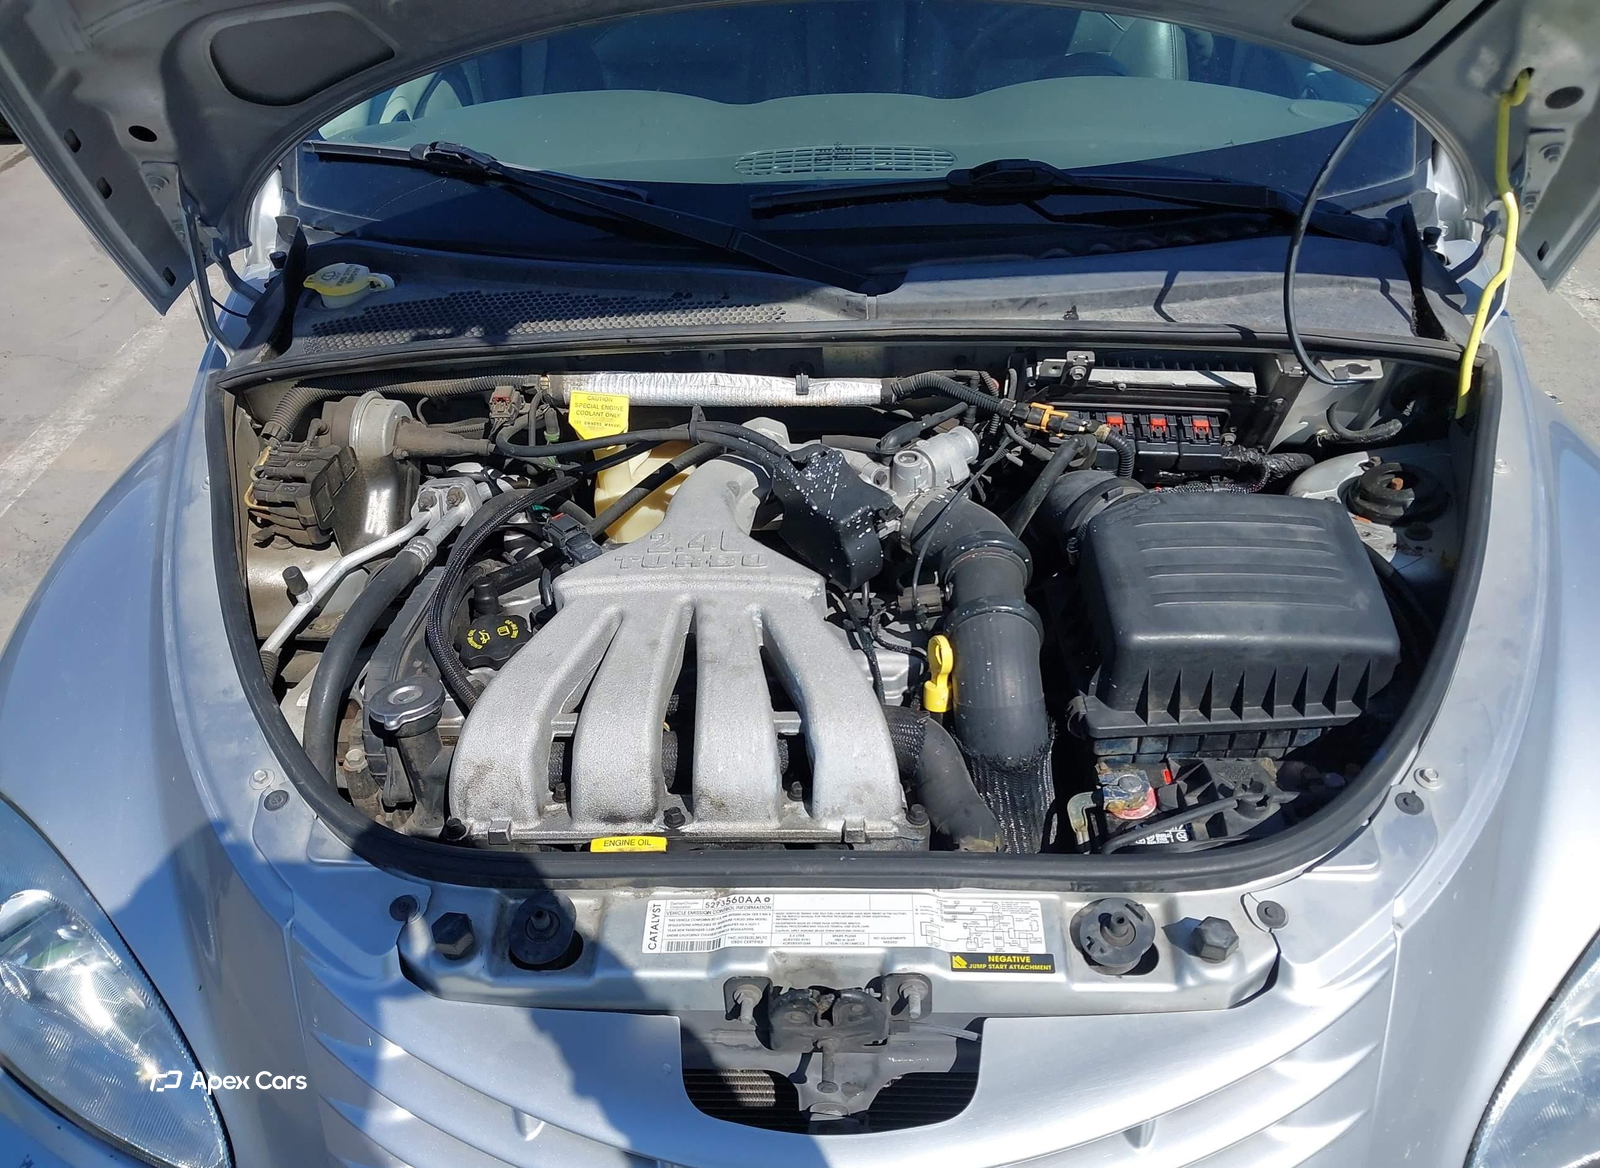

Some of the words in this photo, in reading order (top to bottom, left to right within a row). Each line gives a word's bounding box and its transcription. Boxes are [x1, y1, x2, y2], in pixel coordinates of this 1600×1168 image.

[646, 529, 742, 554] 2.4L
[614, 554, 768, 570] TURBO
[604, 839, 636, 847] ENGINE
[648, 903, 662, 950] CATALYST
